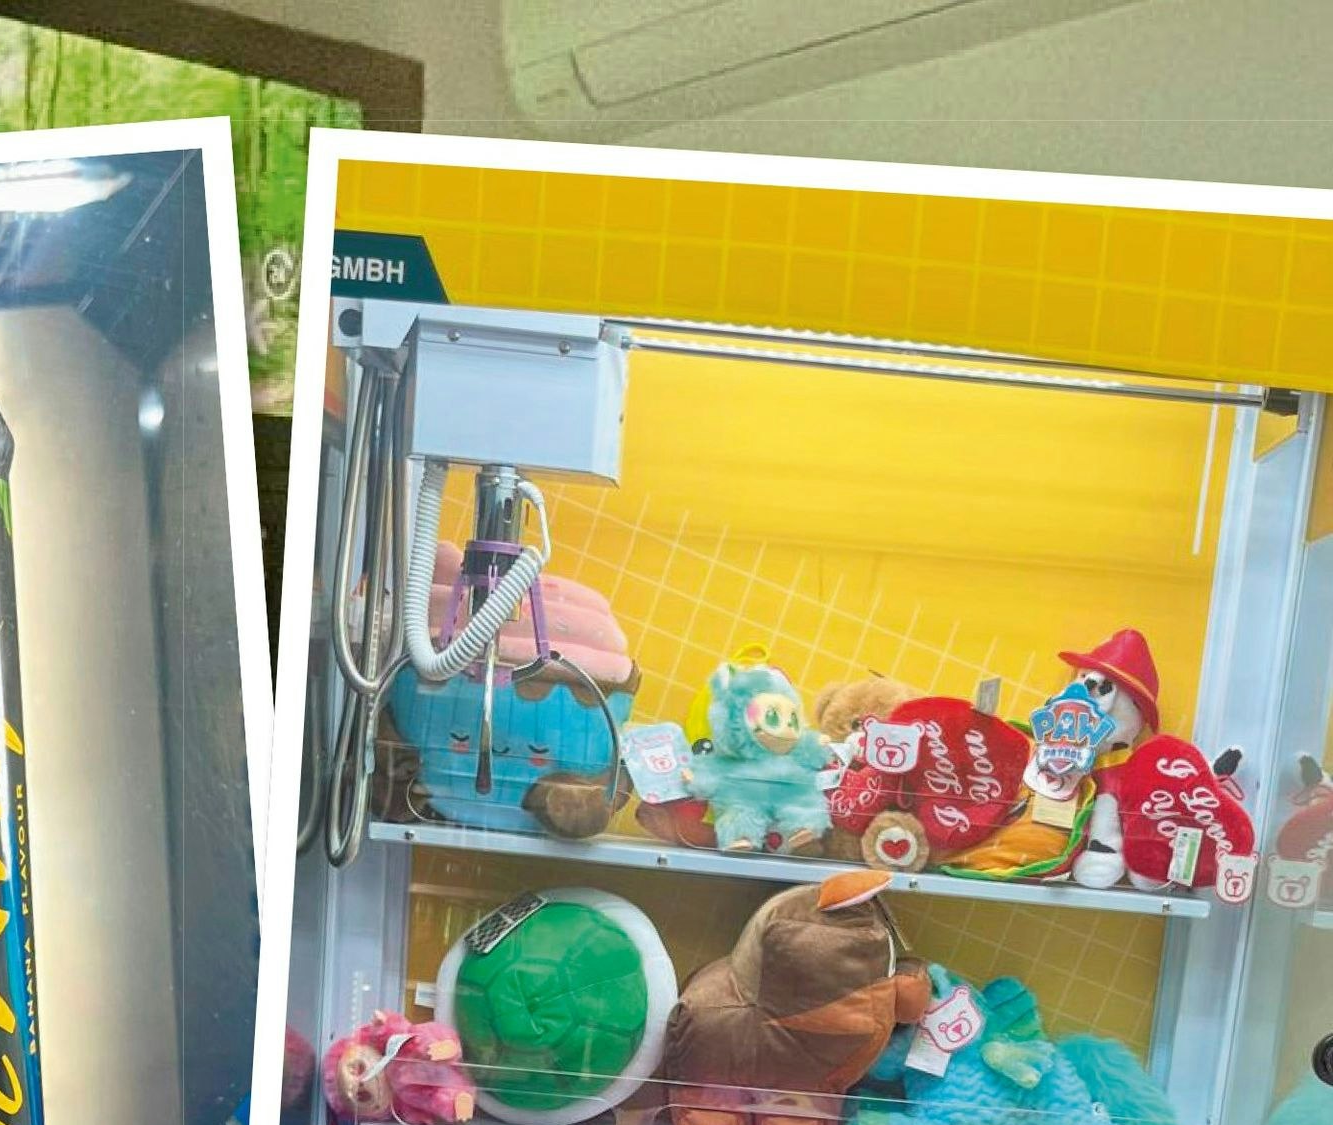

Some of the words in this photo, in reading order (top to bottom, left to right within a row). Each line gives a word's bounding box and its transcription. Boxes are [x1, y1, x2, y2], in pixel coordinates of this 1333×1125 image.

[331, 254, 406, 285] GMBH
[1031, 708, 1116, 747] PAW
[15, 782, 31, 918] FLAVOUR
[1141, 789, 1182, 850] Yo
[23, 936, 37, 1057] BANANA
